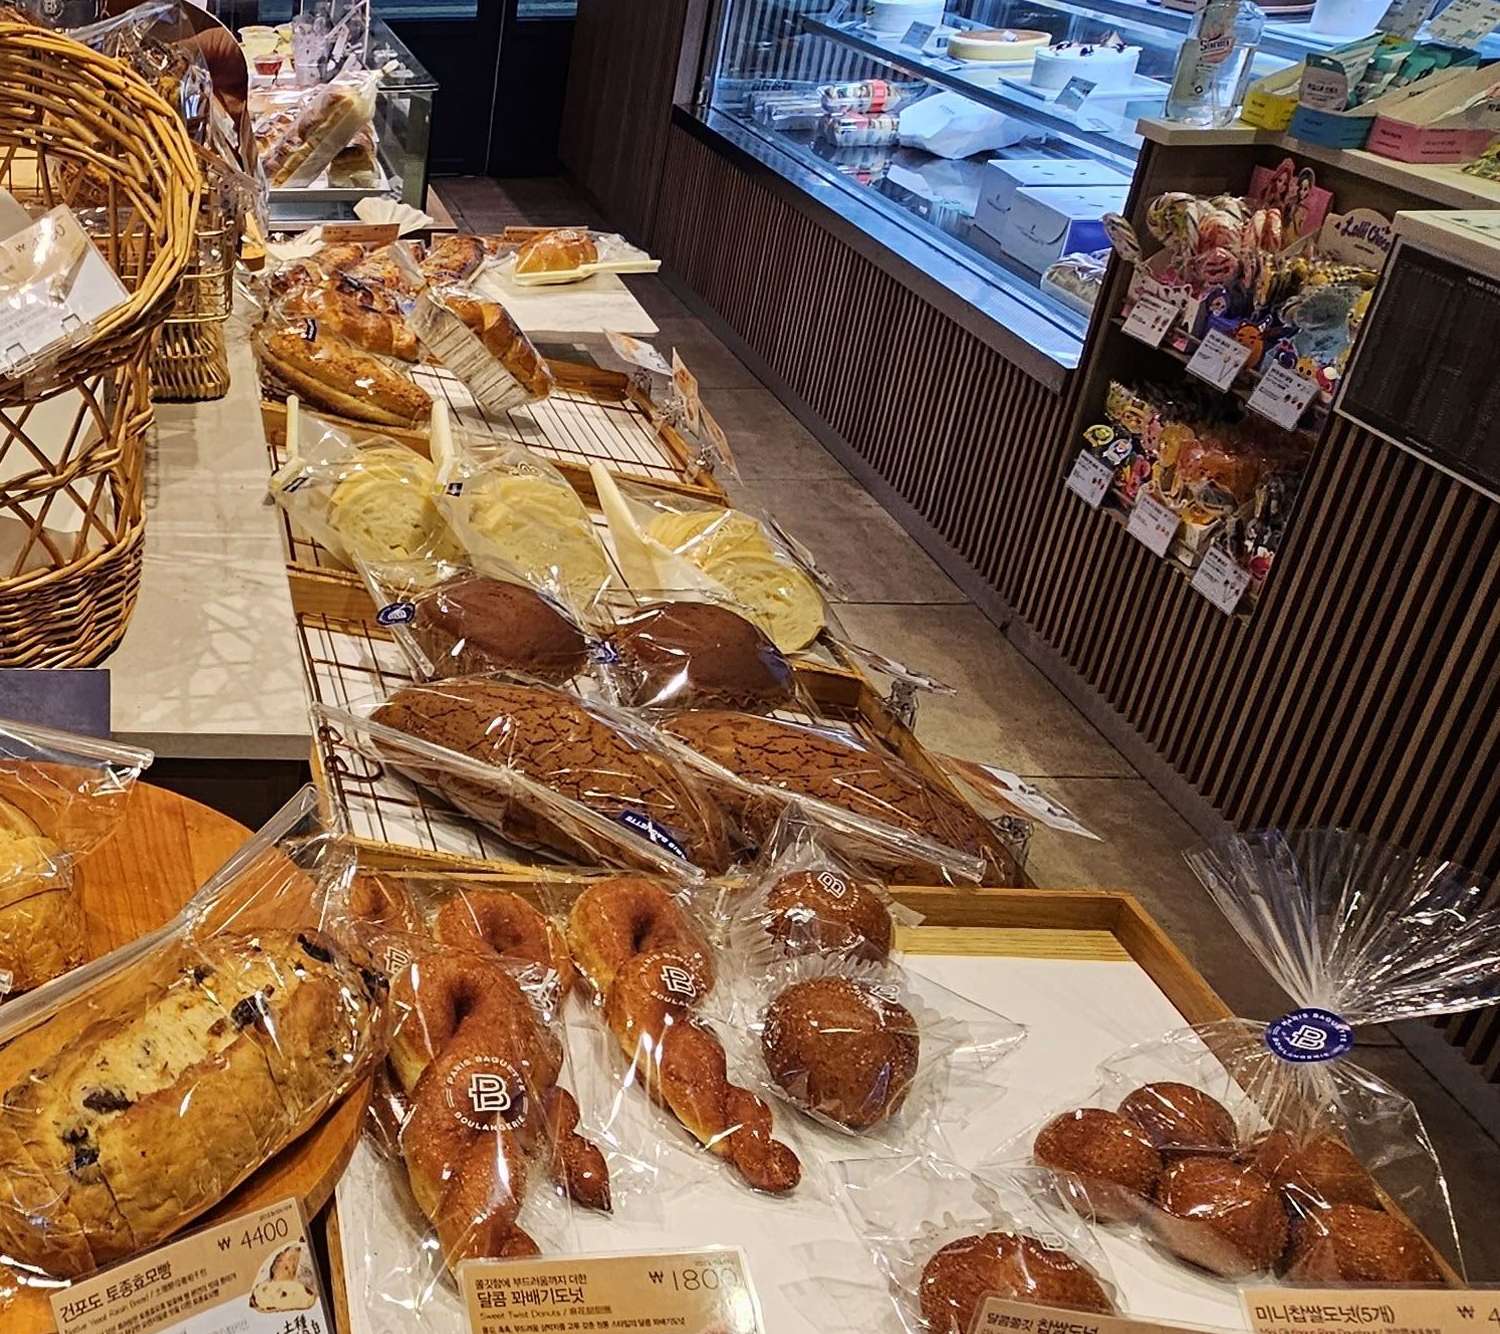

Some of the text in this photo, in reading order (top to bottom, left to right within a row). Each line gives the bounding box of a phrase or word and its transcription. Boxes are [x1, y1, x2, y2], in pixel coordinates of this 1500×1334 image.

[237, 1216, 291, 1251] 4400
[512, 1274, 567, 1287] 부드러움까지
[569, 1274, 587, 1284] 더한
[671, 1267, 738, 1291] 1800
[57, 1260, 176, 1324] 건포도 토종효모빵
[477, 1287, 585, 1308] 달콤 꽈배기도넛
[480, 1308, 560, 1320] Sweet Twist Donuts
[1255, 1304, 1396, 1324] 미니찹쌀도넛(5개)
